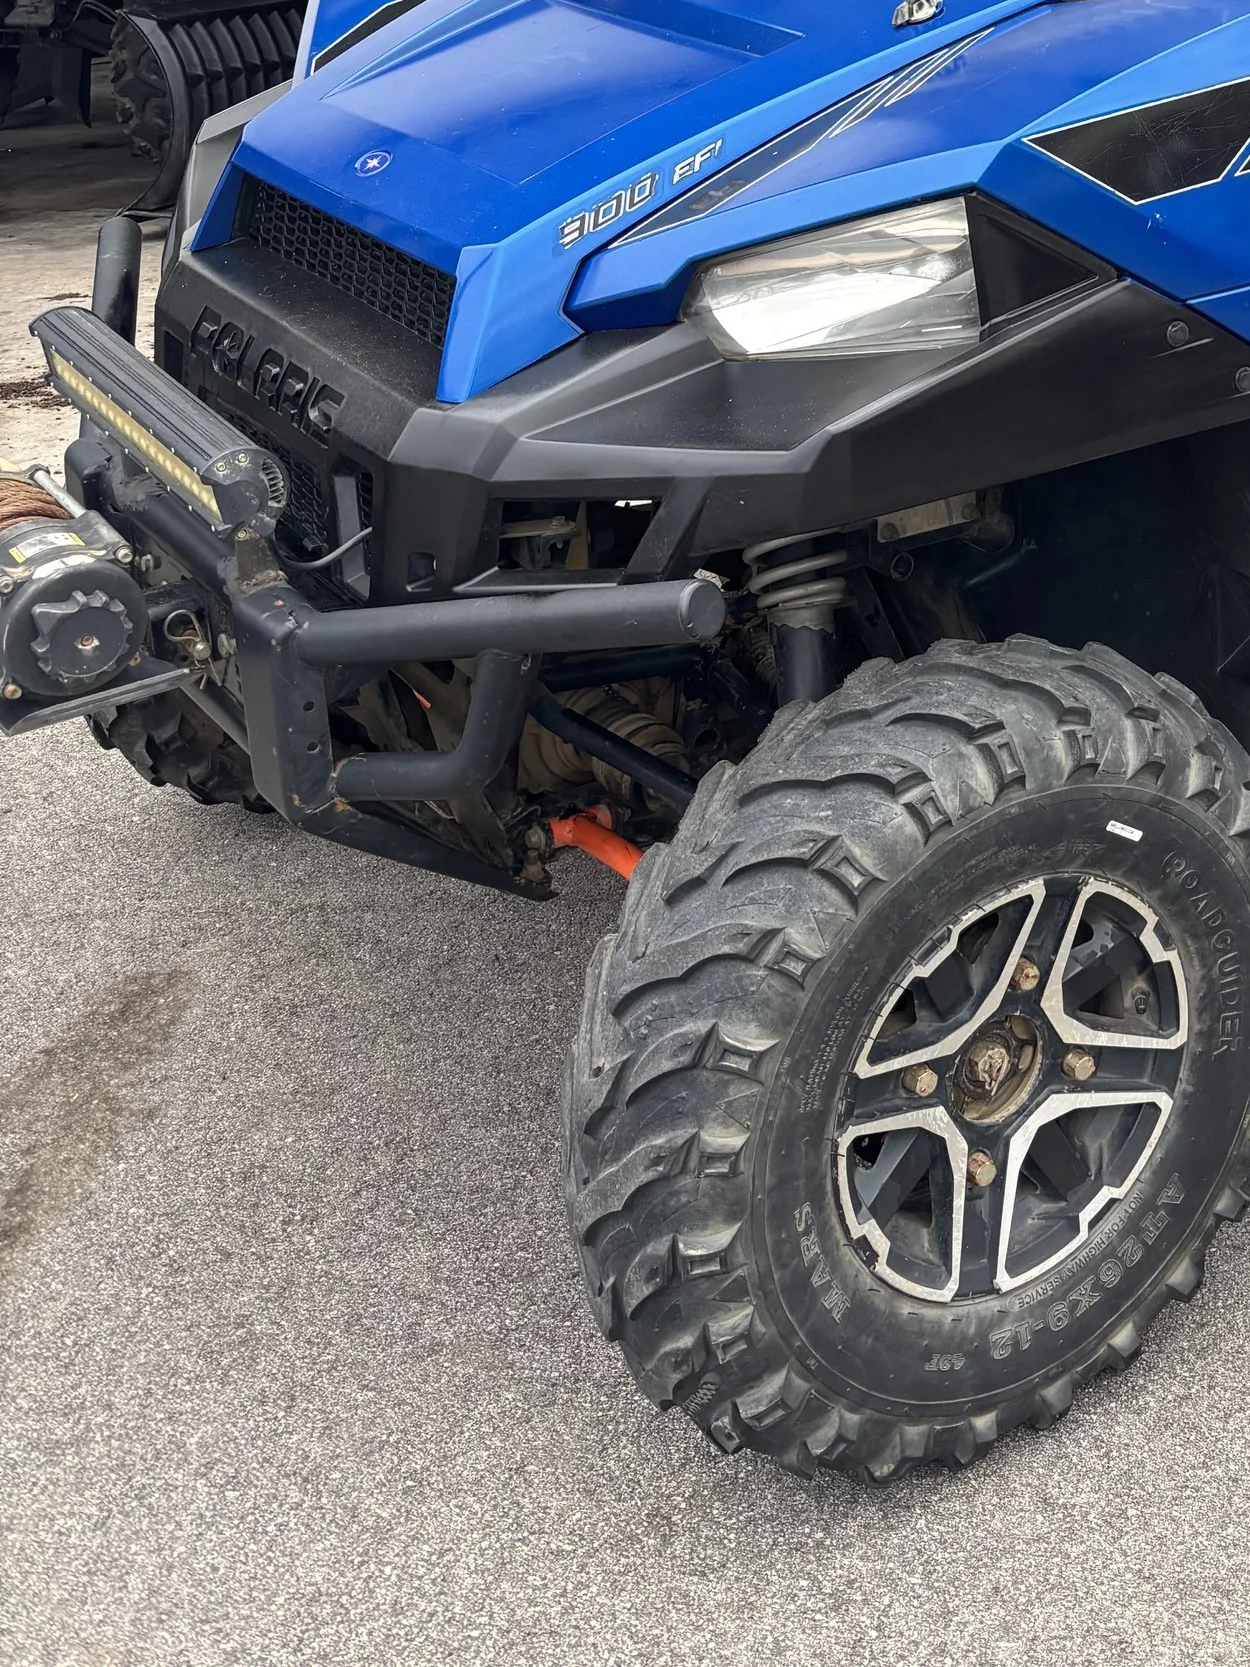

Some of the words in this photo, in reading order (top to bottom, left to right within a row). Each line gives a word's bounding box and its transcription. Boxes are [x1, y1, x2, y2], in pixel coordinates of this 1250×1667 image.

[190, 304, 346, 449] POLARIS
[794, 1201, 852, 1325] MARS
[1017, 1275, 1062, 1309] SERVICE
